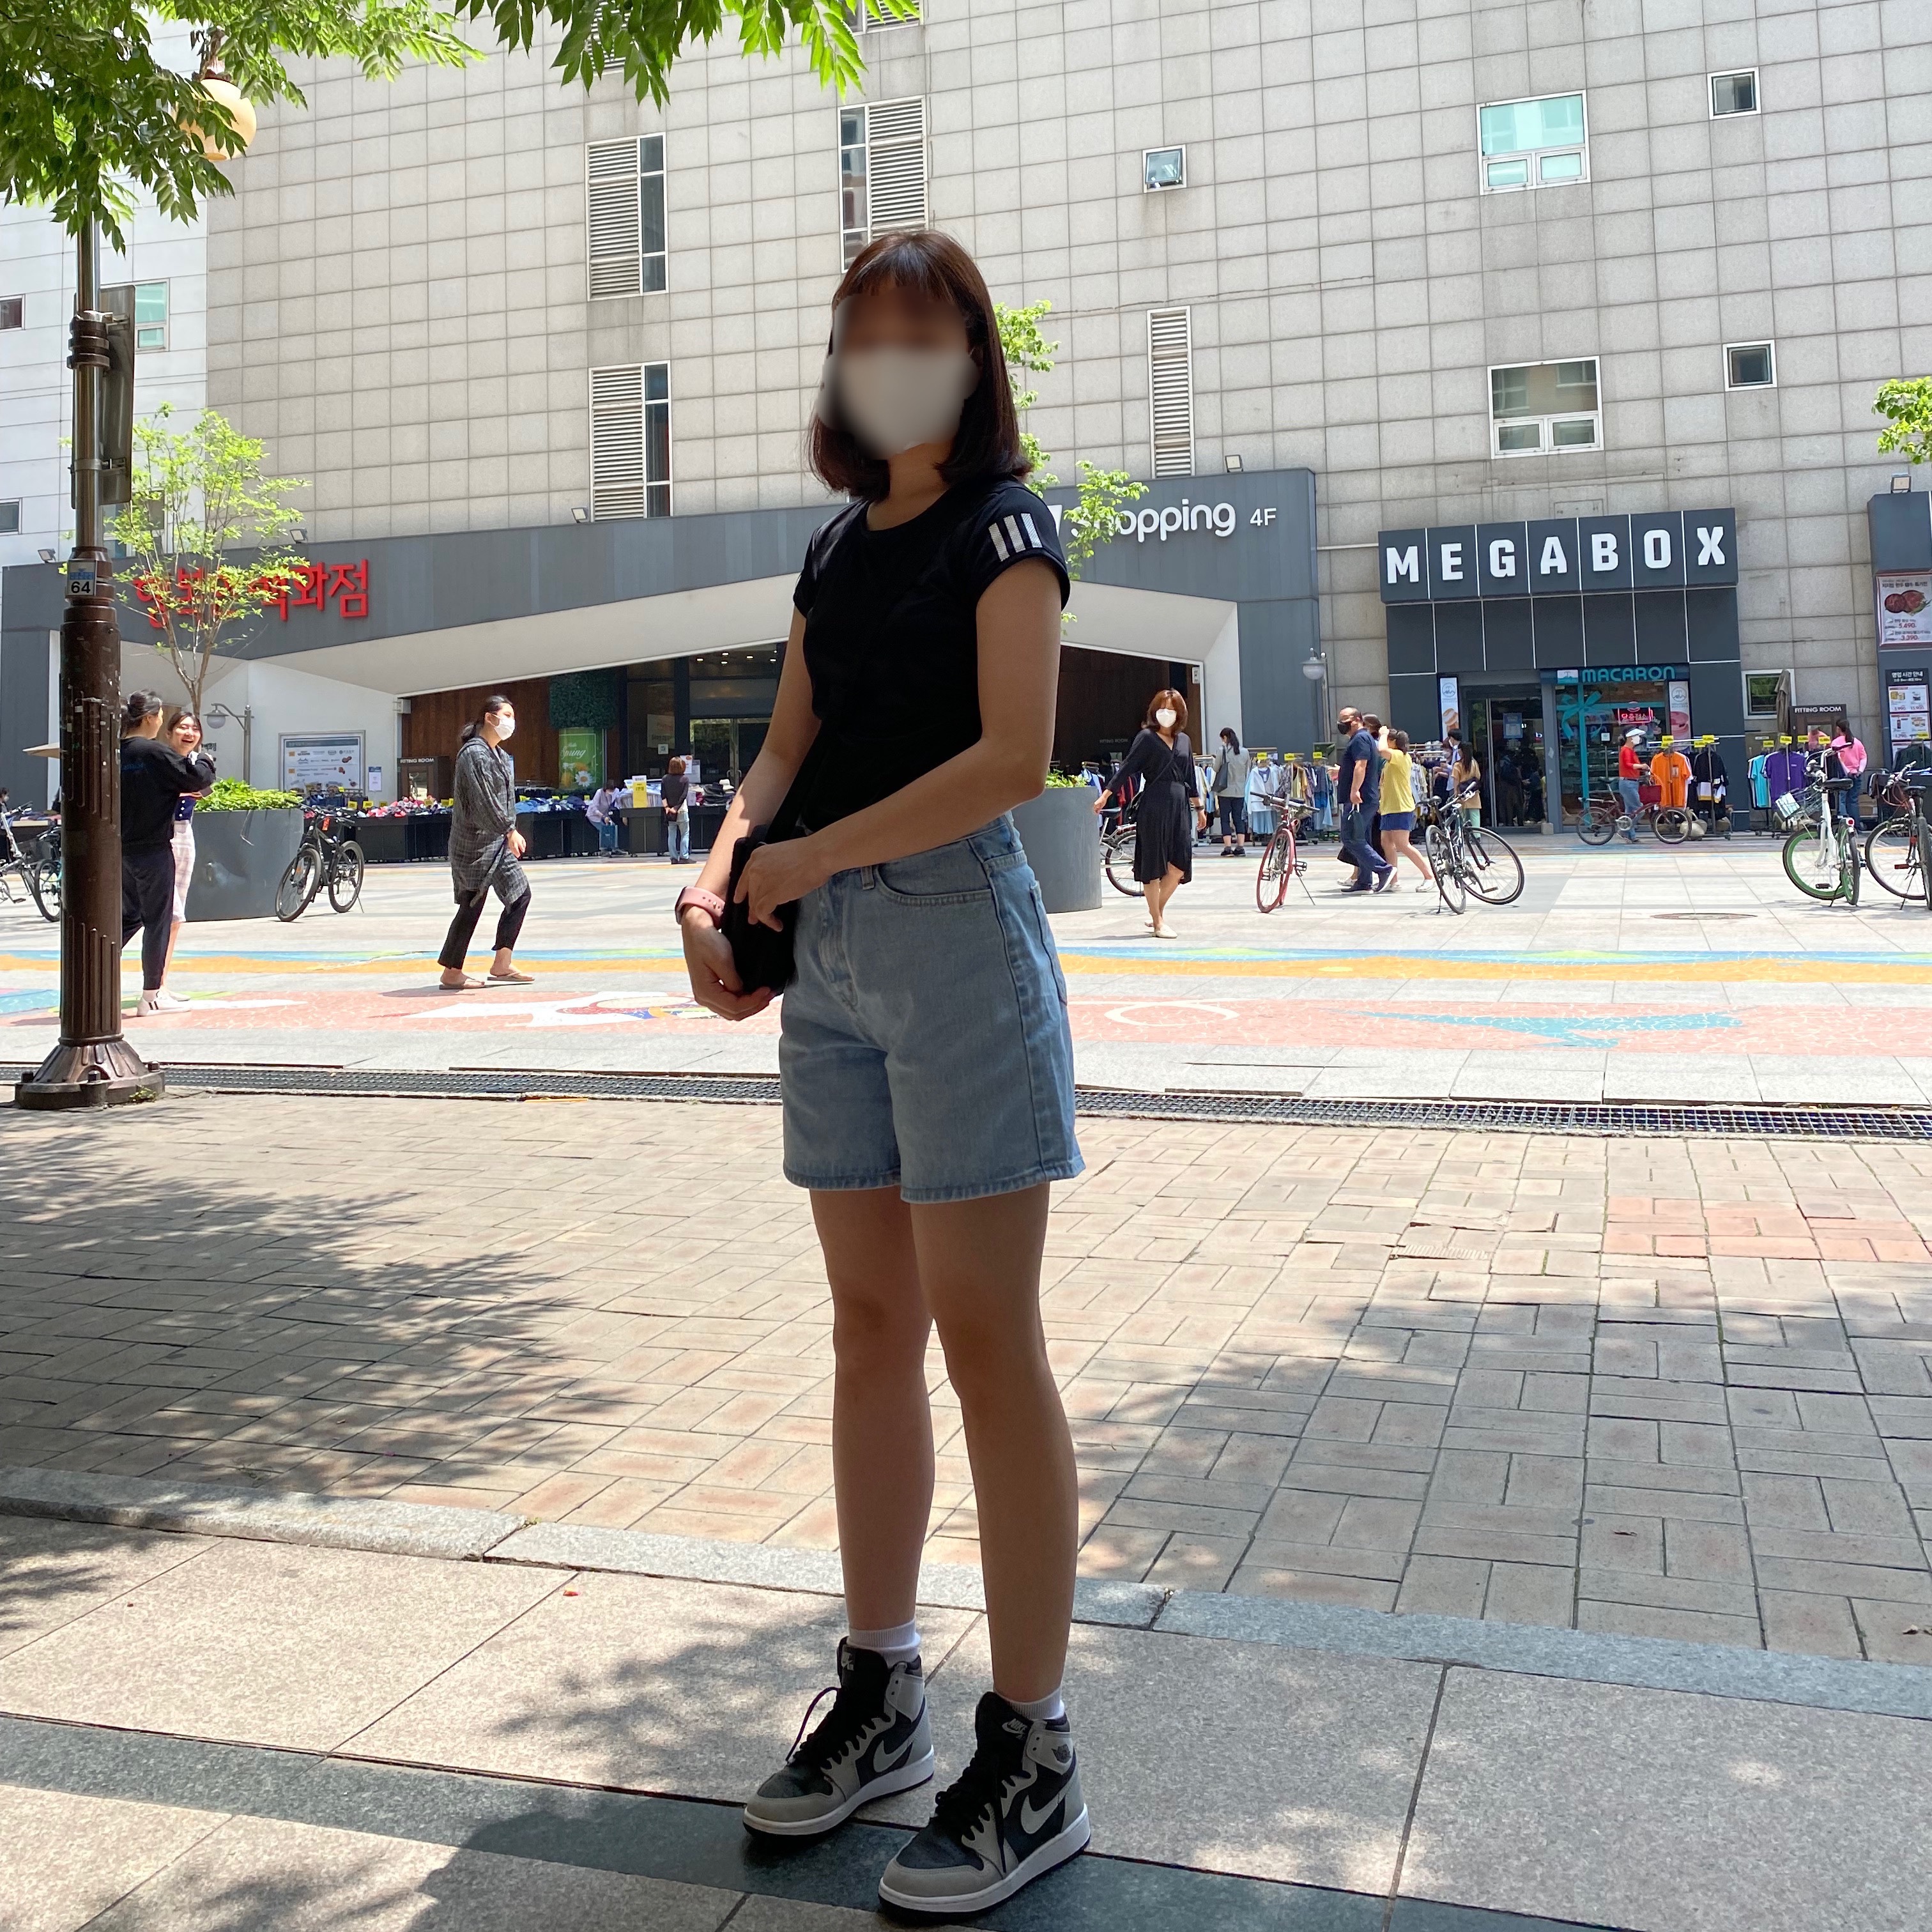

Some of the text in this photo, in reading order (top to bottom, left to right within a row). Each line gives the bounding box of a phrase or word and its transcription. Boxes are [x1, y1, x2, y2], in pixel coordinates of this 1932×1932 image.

[1250, 507, 1277, 526] 4F
[1386, 526, 1726, 584] MEGABOX
[71, 581, 91, 594] 64
[1581, 666, 1676, 683] MACARON
[561, 746, 586, 760] Spring
